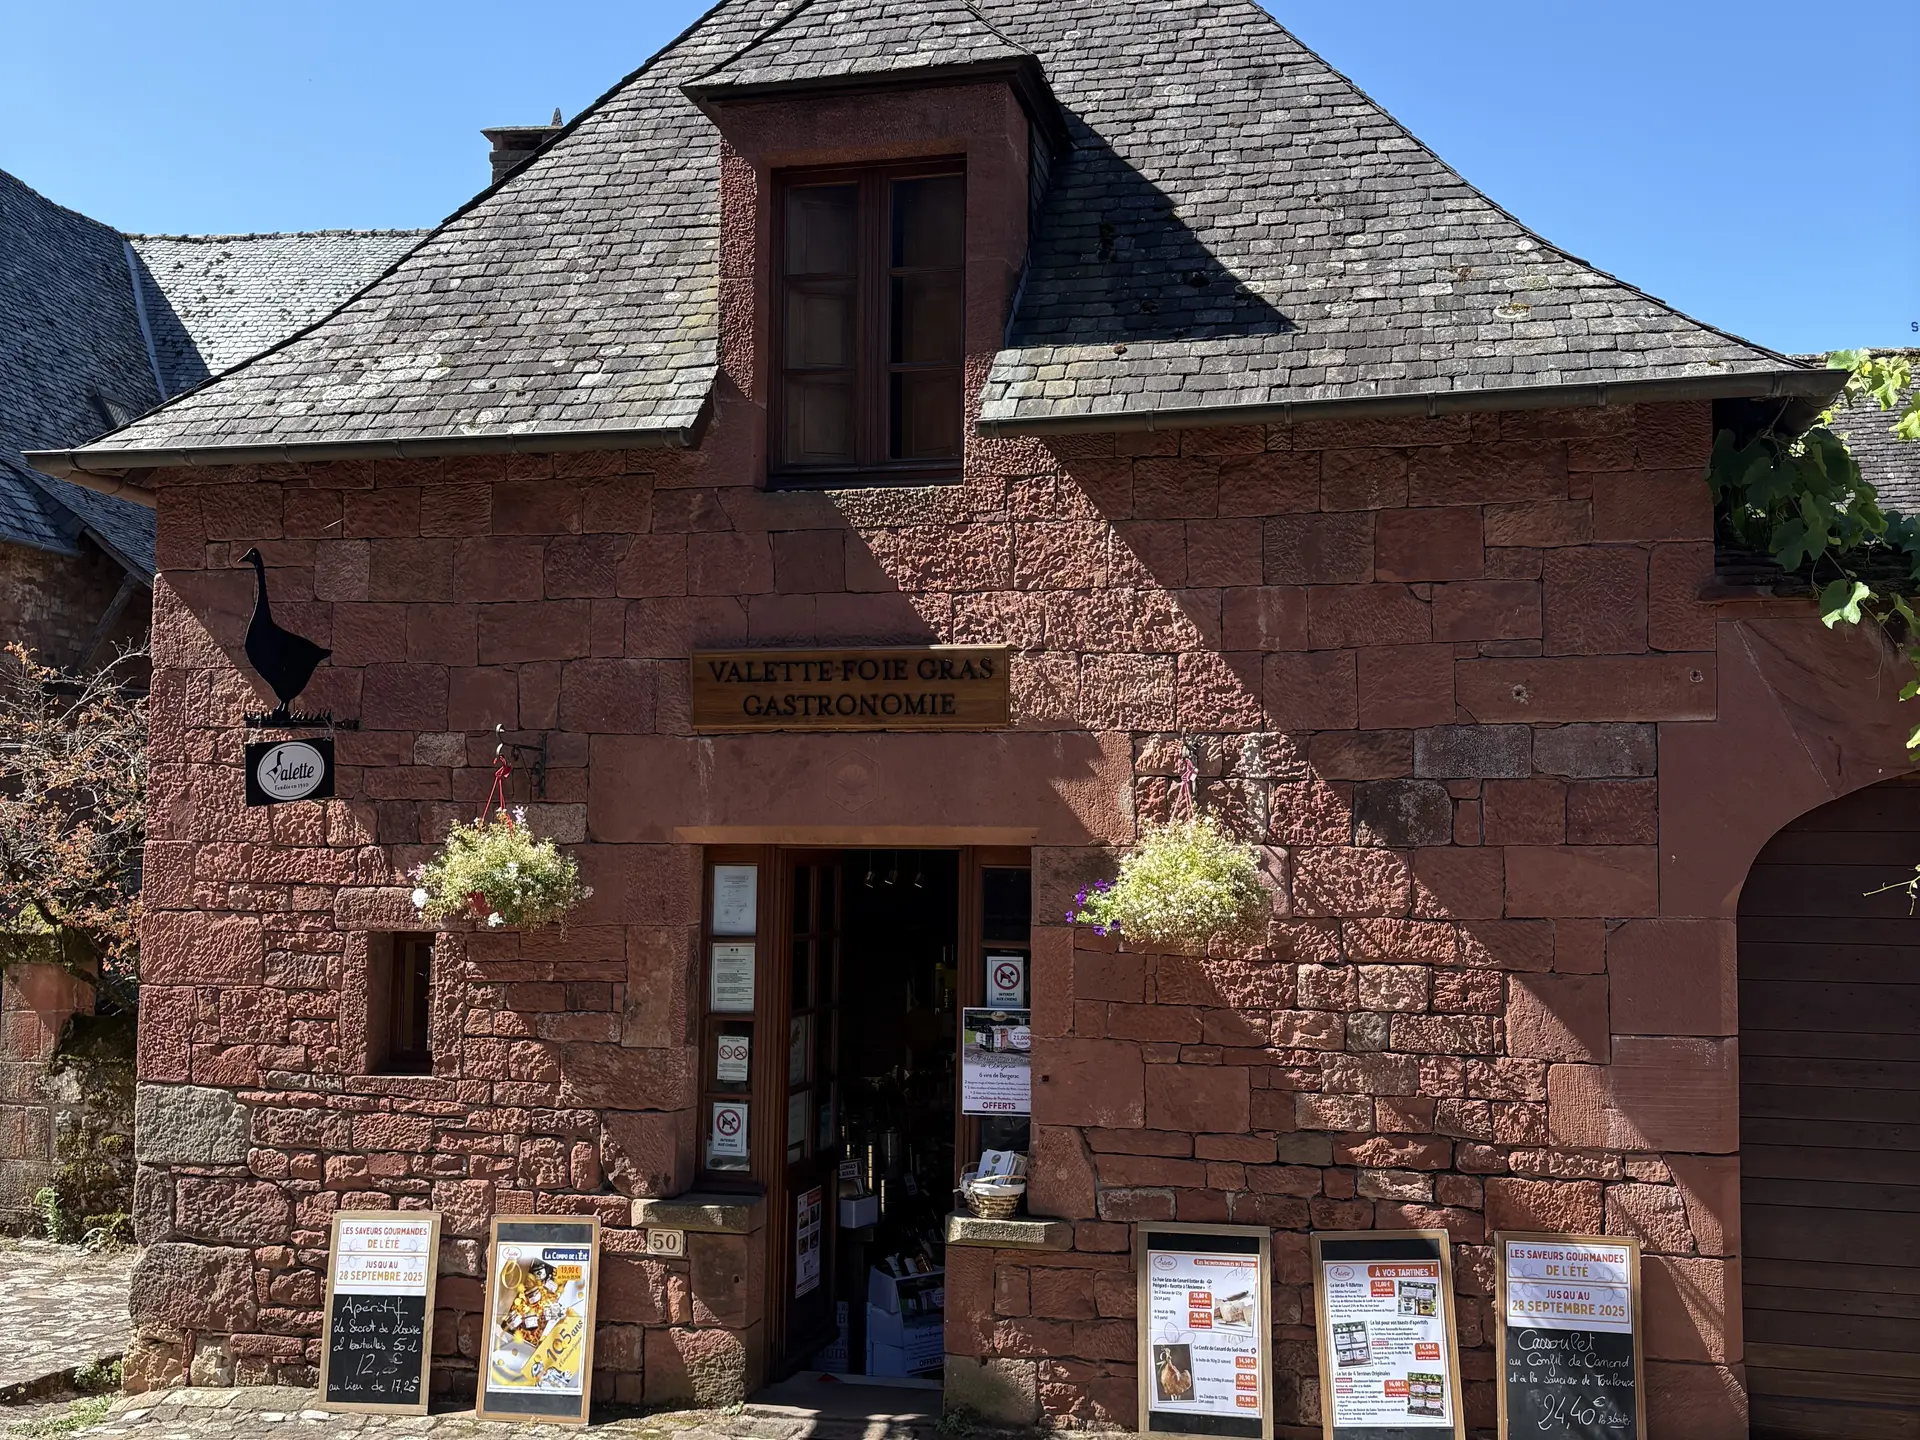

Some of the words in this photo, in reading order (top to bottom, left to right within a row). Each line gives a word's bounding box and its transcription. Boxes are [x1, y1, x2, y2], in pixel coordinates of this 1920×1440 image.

[708, 660, 833, 683] VALETTE
[841, 659, 908, 682] FOIE
[917, 658, 994, 681] GRAS
[743, 693, 956, 716] GASTRONOMIE
[982, 1102, 1016, 1110] OFFERTS
[355, 1227, 381, 1235] SAVEURS
[368, 1239, 377, 1248] DE
[380, 1237, 400, 1249] L'ÉTÉ
[653, 1236, 677, 1250] 50
[1510, 1249, 1525, 1259] LES
[1527, 1250, 1563, 1260] SAVEURS
[1566, 1252, 1624, 1263] GOURMANDES
[366, 1260, 398, 1269] JUSQU'AU
[1375, 1267, 1380, 1276] À
[1398, 1268, 1429, 1276] TARTINES
[1546, 1265, 1559, 1276] DE
[1562, 1263, 1588, 1277] L'ÉTÉ
[339, 1271, 348, 1280] 28
[351, 1271, 401, 1281] SEPTEMBRE
[403, 1272, 422, 1281] 2025
[1547, 1290, 1590, 1300] JUSQU'AU
[342, 1296, 408, 1324] Apéritif
[1512, 1300, 1524, 1311] 28
[1528, 1301, 1596, 1315] SEPTEMBRE
[1599, 1305, 1625, 1317] 2025
[379, 1323, 388, 1333] de
[546, 1329, 571, 1362] 105
[571, 1320, 583, 1337] ans
[1518, 1329, 1595, 1352] Cassoulet
[919, 1357, 943, 1367] OFFERTS
[1509, 1358, 1521, 1366] au
[1527, 1352, 1563, 1377] Confit
[1568, 1354, 1581, 1366] de
[1584, 1352, 1629, 1368] Canard
[345, 1376, 363, 1390] lieu
[371, 1380, 385, 1392] de
[1582, 1374, 1590, 1385] de
[1595, 1373, 1634, 1387] Toulouse
